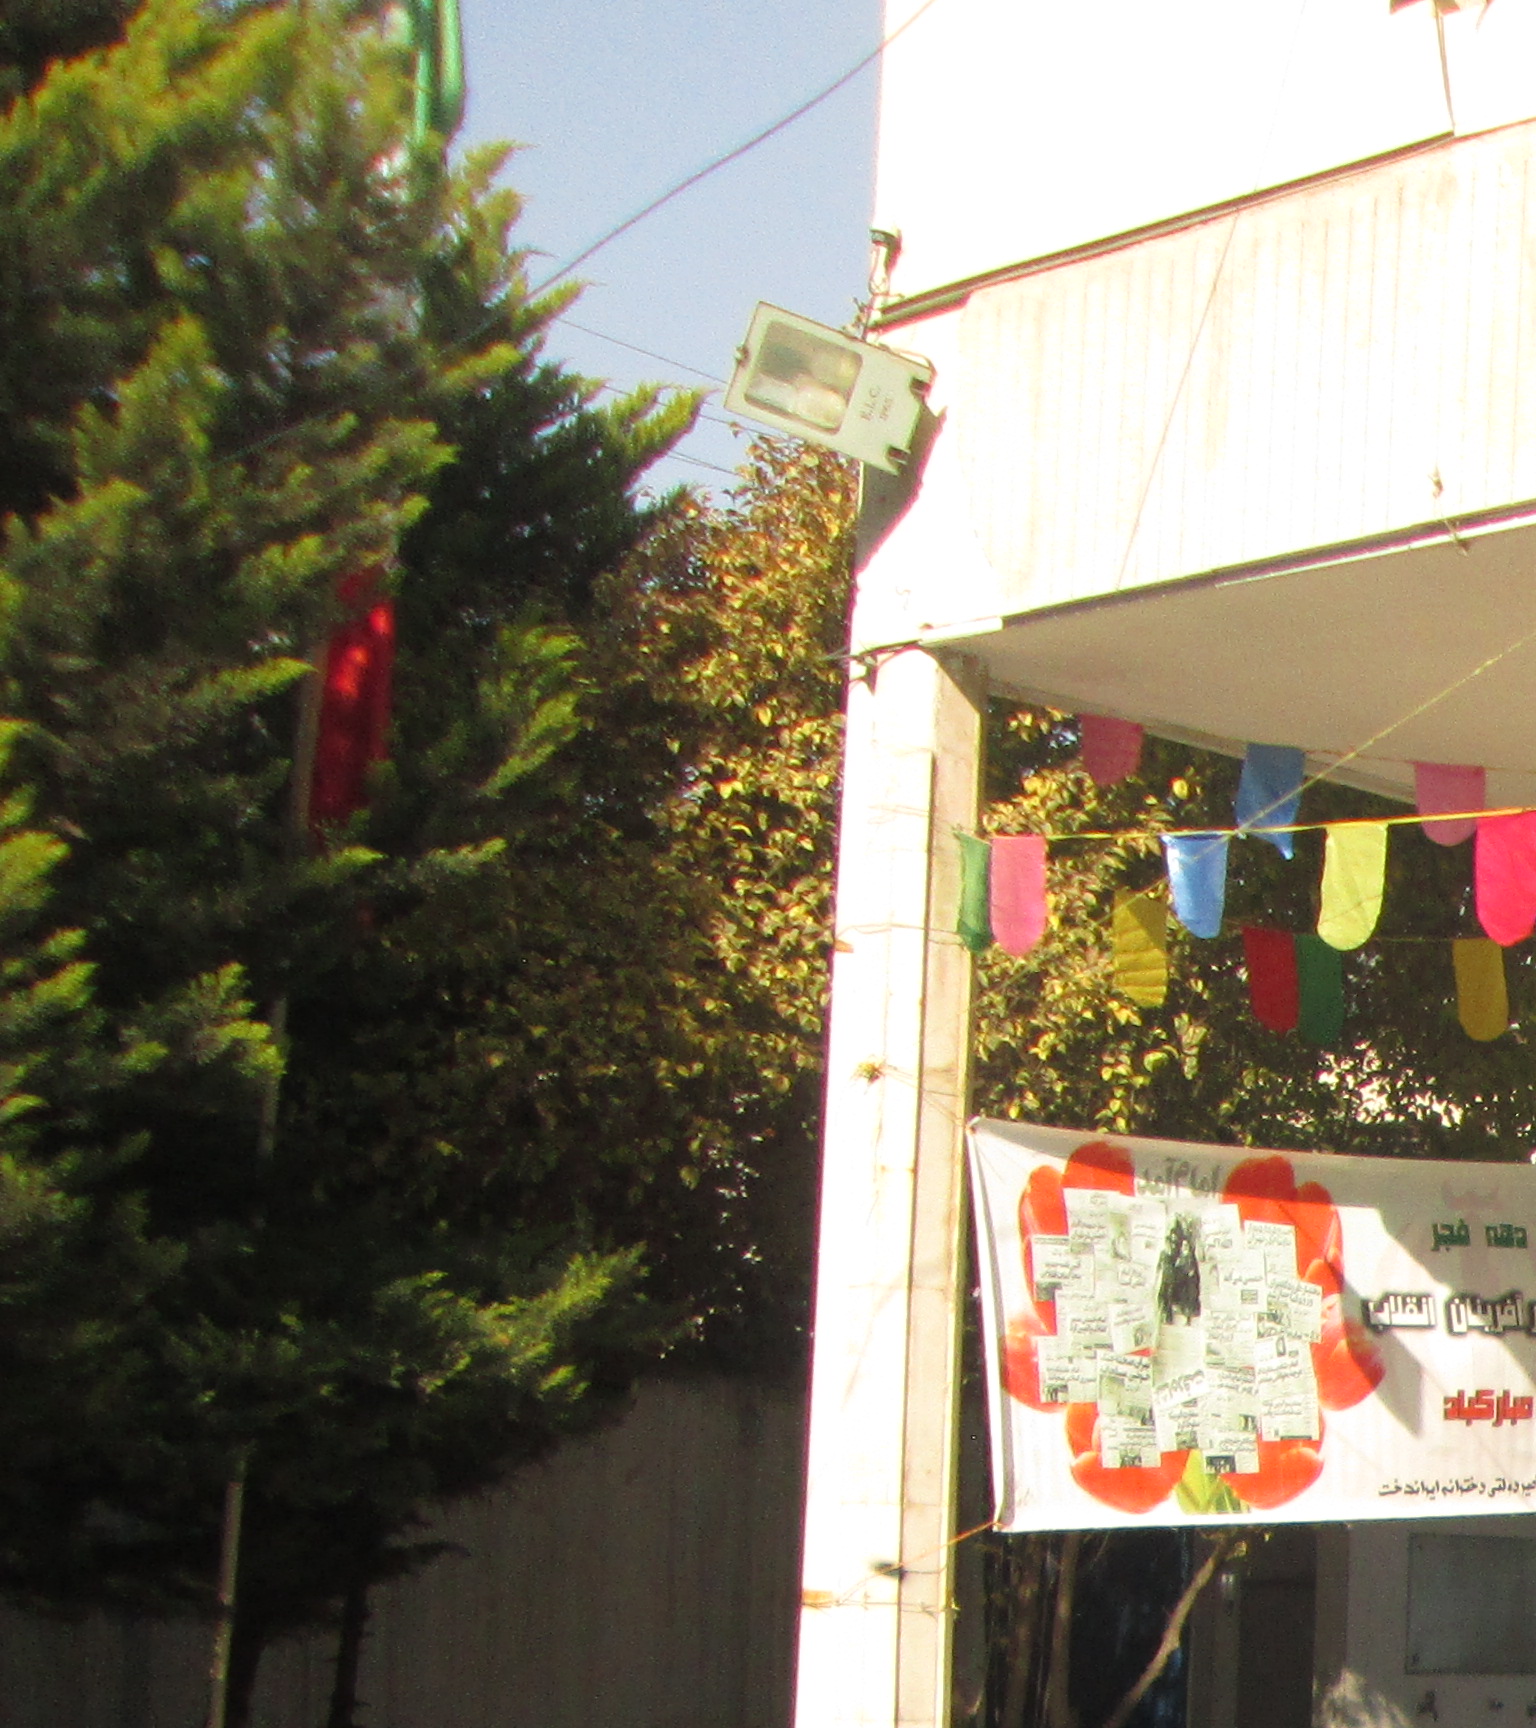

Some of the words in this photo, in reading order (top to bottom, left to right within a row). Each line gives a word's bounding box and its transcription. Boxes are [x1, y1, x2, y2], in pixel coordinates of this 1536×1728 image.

[1430, 1217, 1472, 1252] فجر
[1485, 1222, 1529, 1249] دهه
[1362, 1291, 1438, 1334] انقلاب
